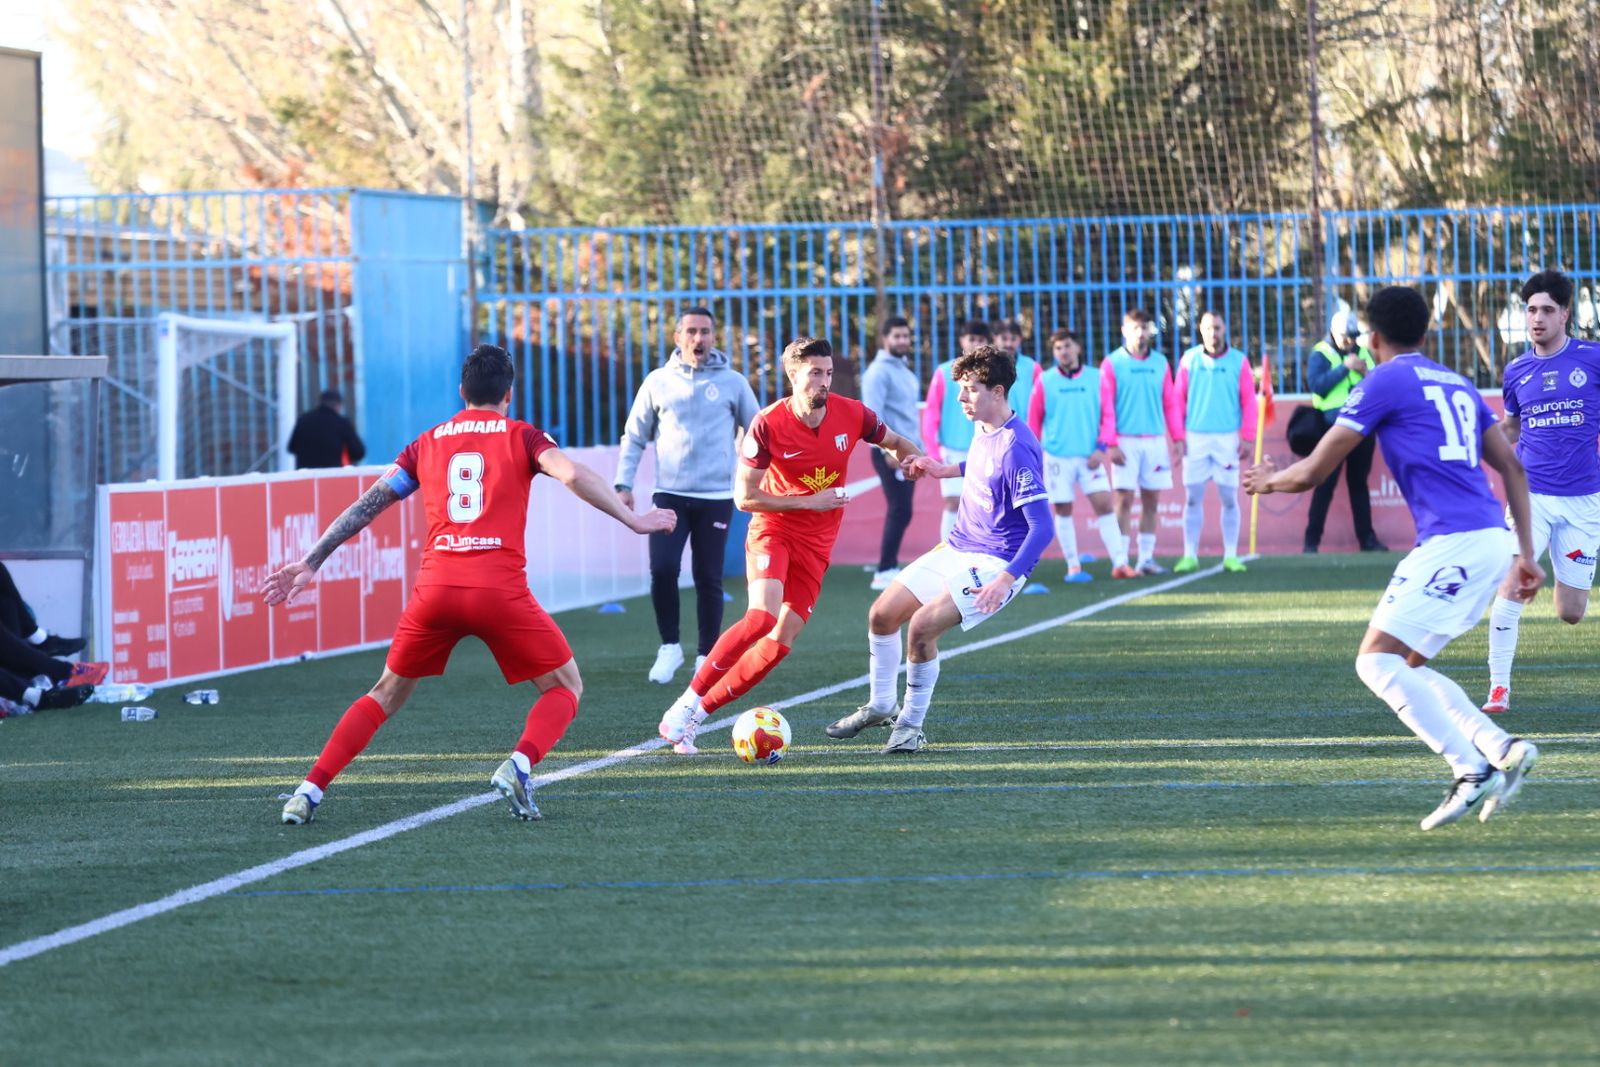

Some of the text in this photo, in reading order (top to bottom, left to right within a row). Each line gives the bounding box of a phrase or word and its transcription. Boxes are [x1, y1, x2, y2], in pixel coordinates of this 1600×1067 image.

[1531, 399, 1584, 415] euronics
[1528, 411, 1582, 429] Danisa
[447, 452, 485, 524] 8
[450, 534, 502, 547] Limcasa
